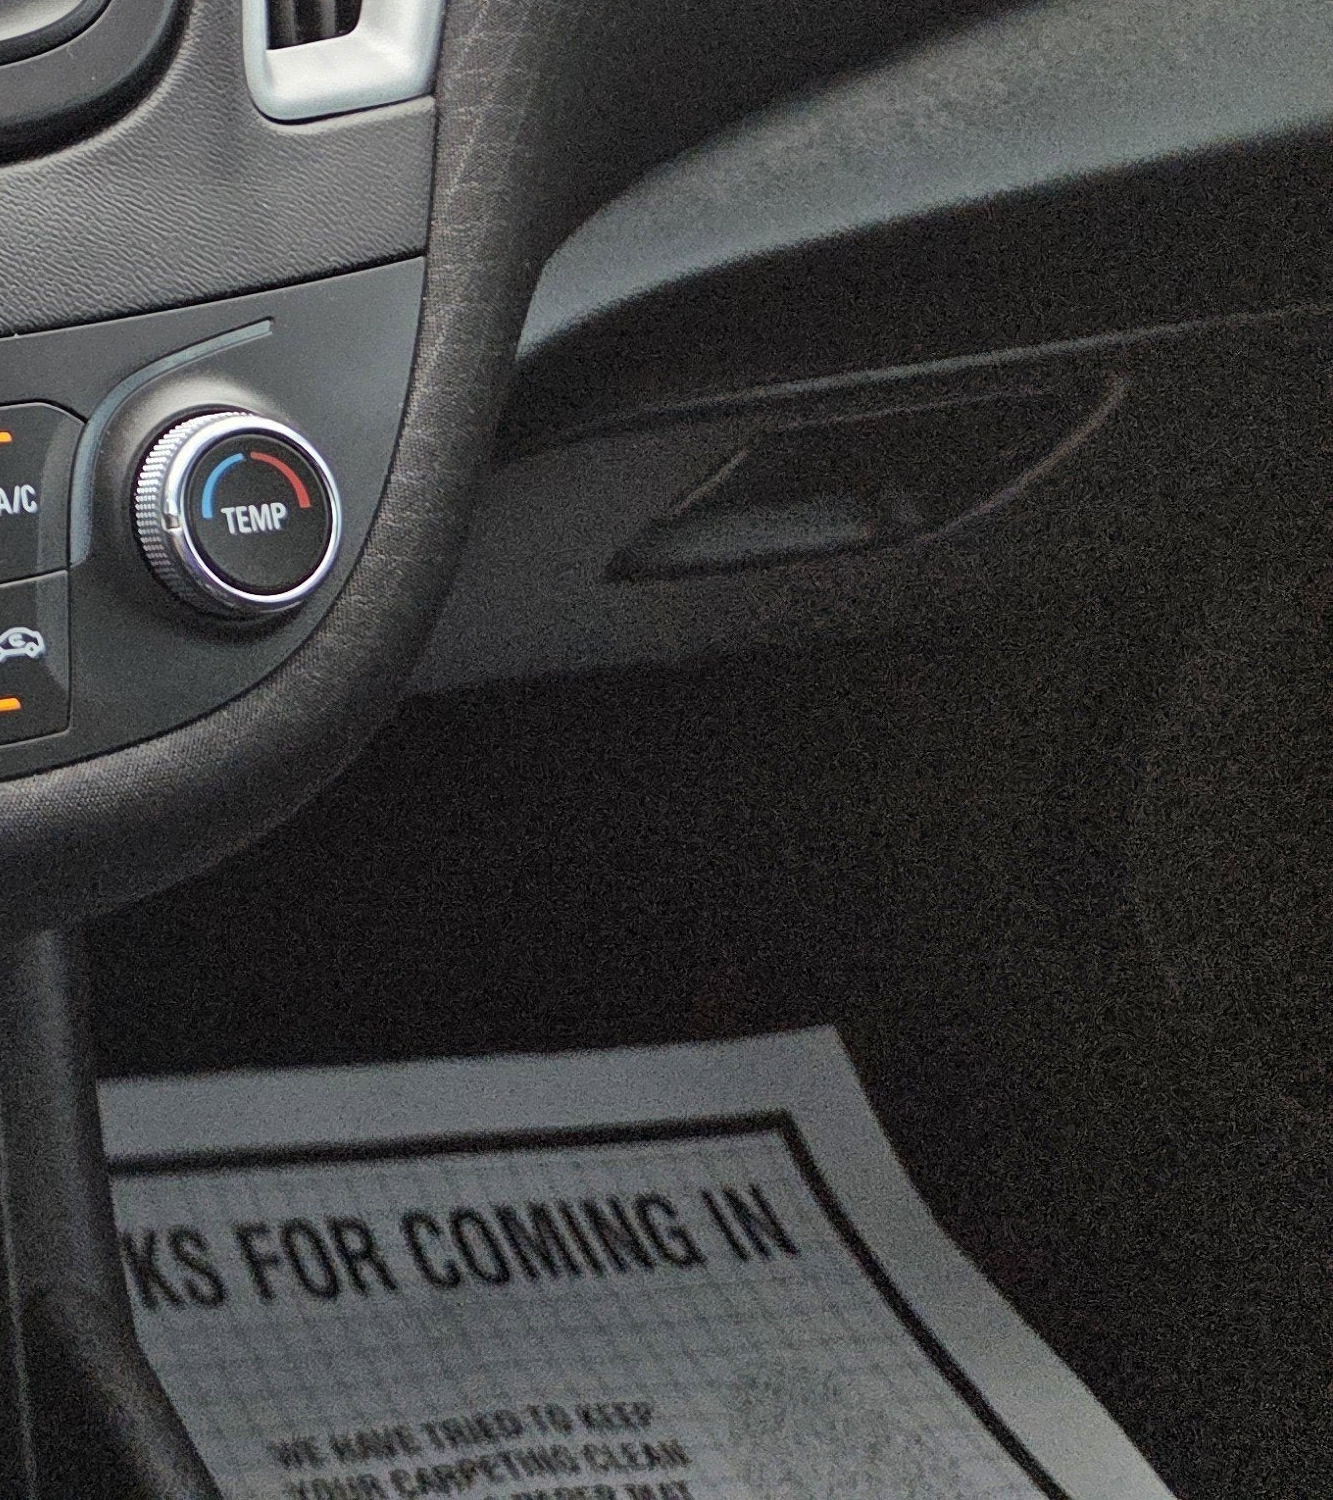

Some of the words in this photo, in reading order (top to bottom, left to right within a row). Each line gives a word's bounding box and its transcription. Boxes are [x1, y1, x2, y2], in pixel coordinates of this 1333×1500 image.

[220, 502, 287, 534] TEMP
[236, 1215, 396, 1304] FOR
[401, 1192, 704, 1292] COMING
[700, 1183, 803, 1263] IN
[526, 1403, 573, 1434] TO
[576, 1401, 655, 1430] KEEP
[582, 1440, 692, 1470] CLEAN
